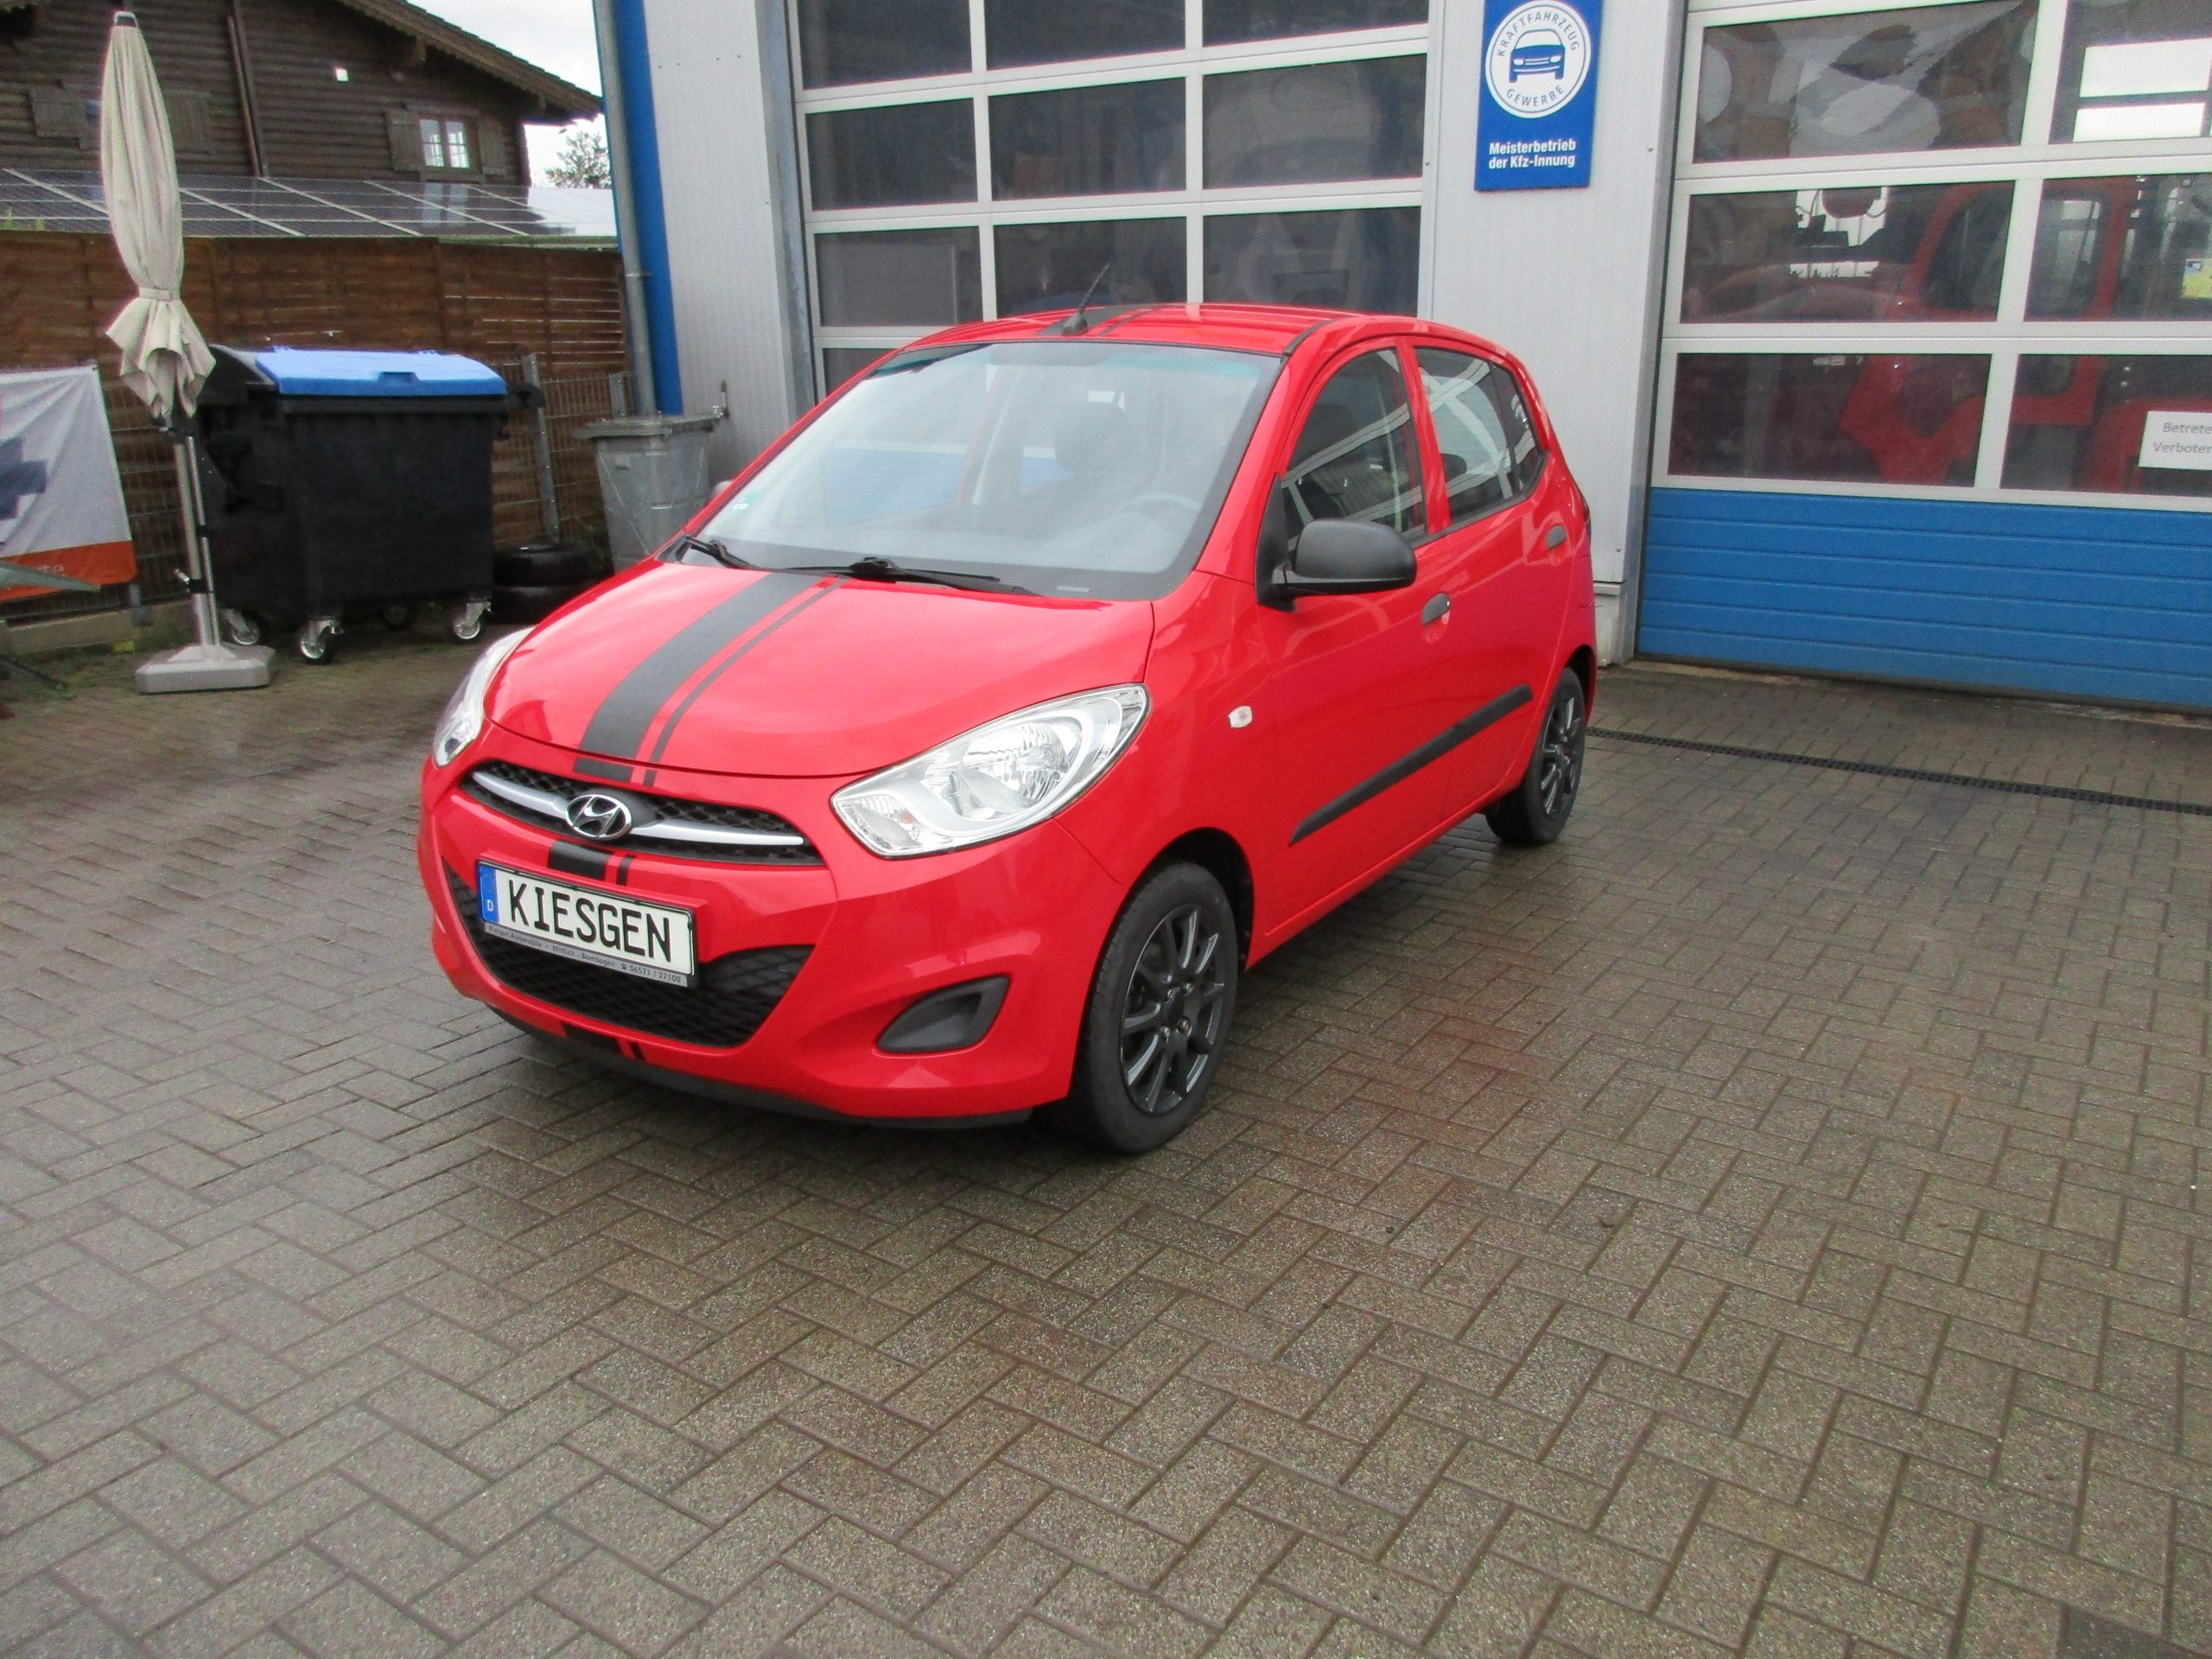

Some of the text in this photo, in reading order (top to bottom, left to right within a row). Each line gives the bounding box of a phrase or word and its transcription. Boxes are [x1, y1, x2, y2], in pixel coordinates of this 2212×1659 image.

[1497, 10, 1580, 57] KRAFTFAHRZEUG
[1506, 85, 1564, 107] GEWERBE
[1489, 138, 1576, 155] Meisterbetrieb
[1488, 154, 1575, 169] der Kfz-Innung
[486, 899, 494, 912] D
[508, 878, 671, 963] KIESGEN
[658, 971, 681, 983] 27100
